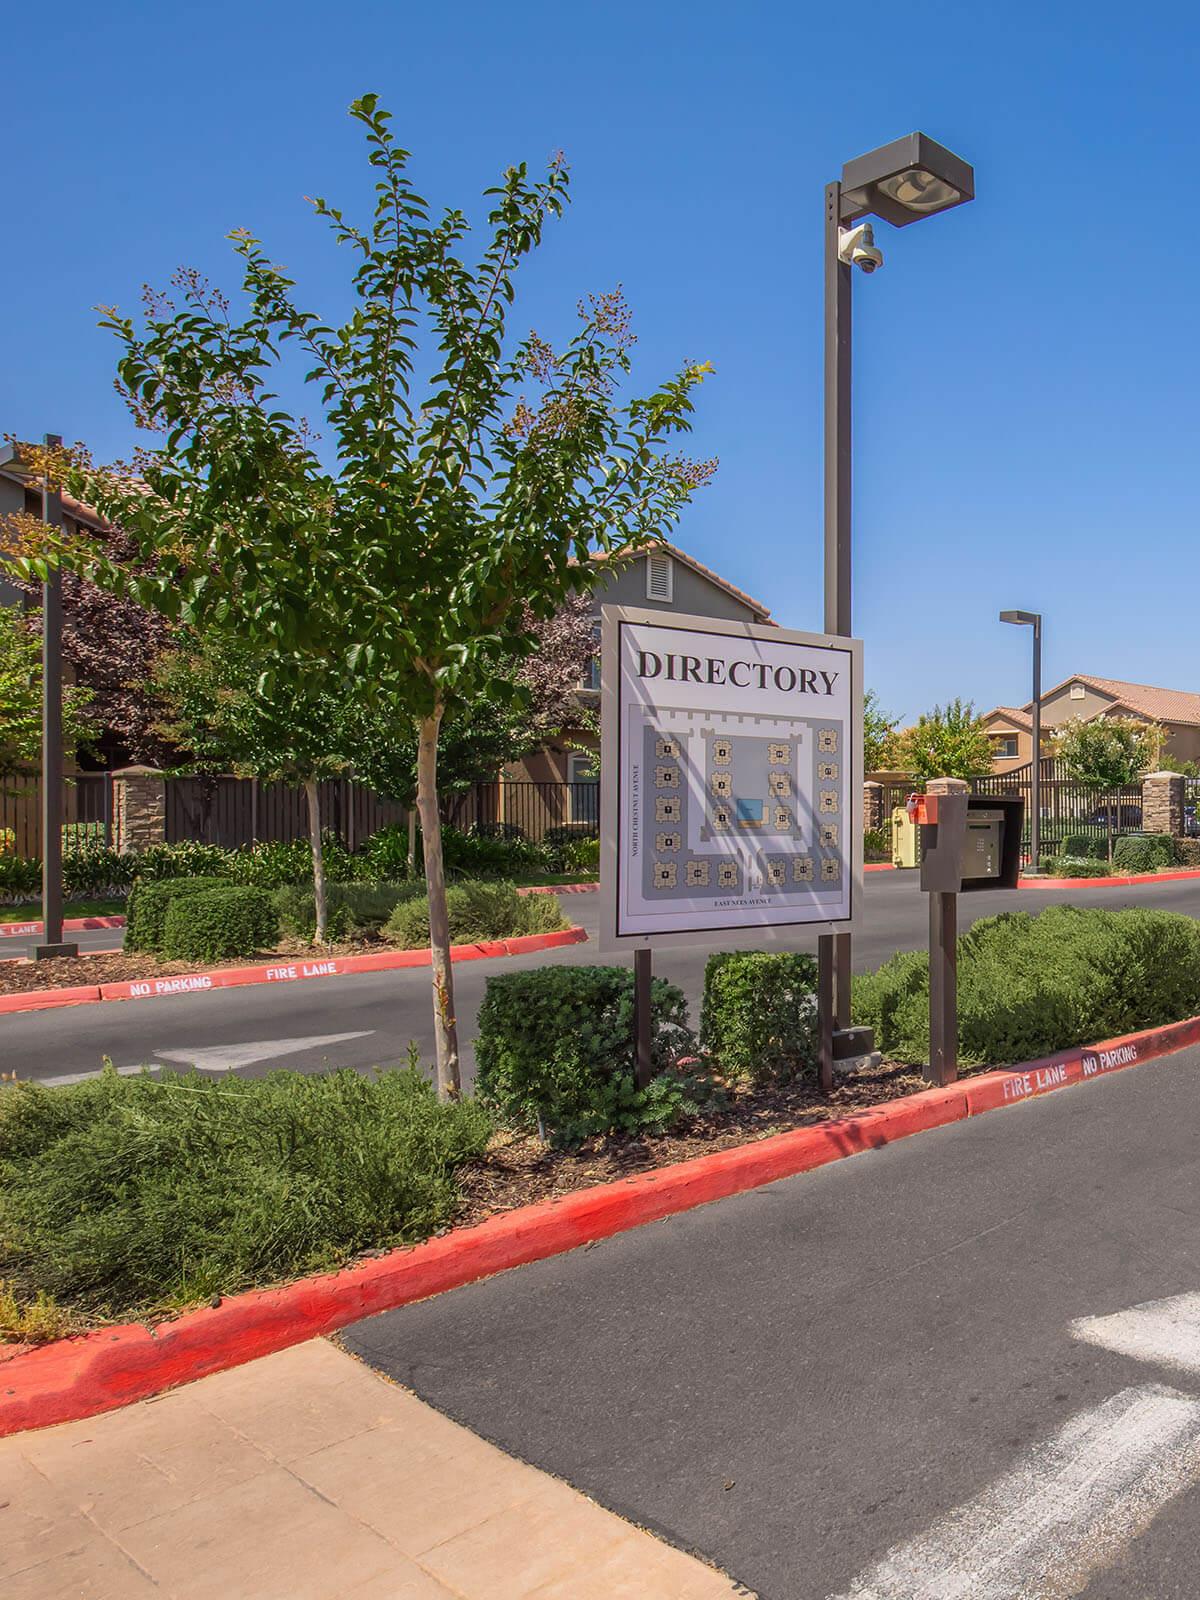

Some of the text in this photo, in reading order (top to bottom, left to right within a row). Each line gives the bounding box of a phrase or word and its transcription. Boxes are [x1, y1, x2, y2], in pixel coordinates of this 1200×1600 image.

[636, 650, 839, 696] DIRECTORY
[11, 925, 38, 935] LANE
[130, 962, 337, 996] NO PARKING FIRE LANE
[1003, 1045, 1137, 1099] FIRE LANE NO PARKING
